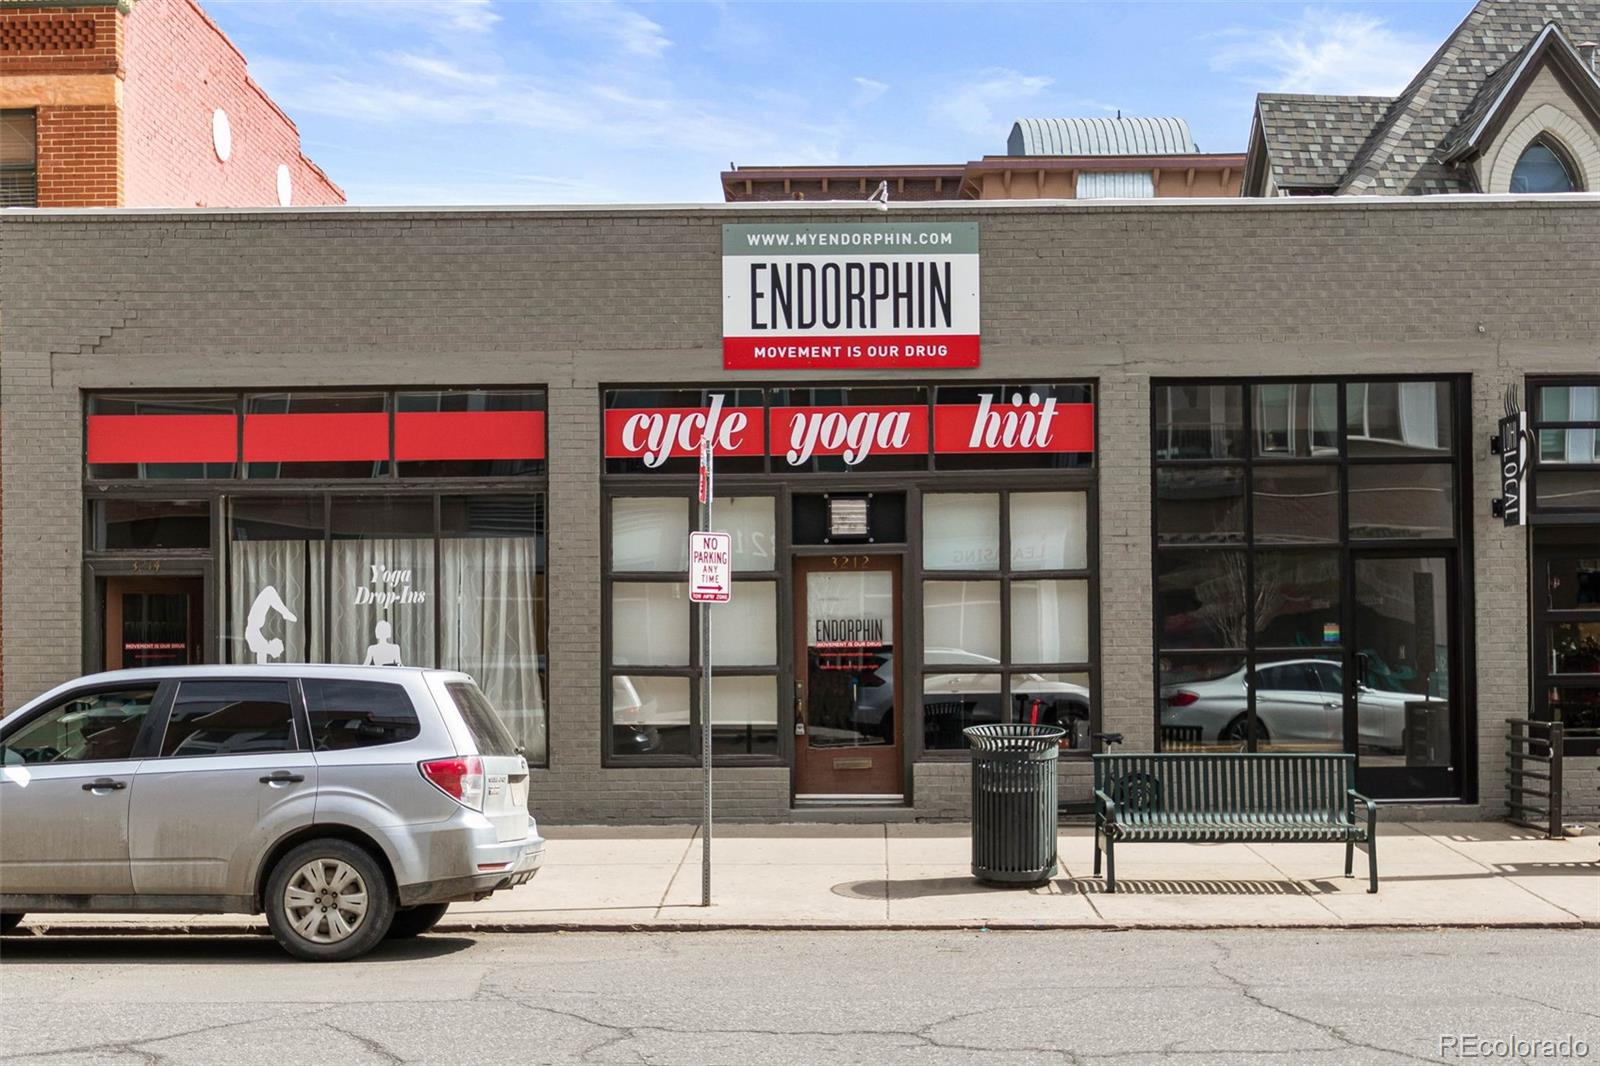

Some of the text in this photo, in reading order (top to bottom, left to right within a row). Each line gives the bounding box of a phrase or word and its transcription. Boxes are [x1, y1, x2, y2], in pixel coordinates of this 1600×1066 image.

[747, 232, 952, 246] WWW.MYENDORPHIN.COM
[750, 262, 952, 330] ENDORPHIN
[754, 345, 948, 358] MOVEMENT IS OUR DRUG
[622, 392, 1059, 468] cycle yoga hiit
[1504, 450, 1518, 519] LOCAL
[703, 537, 719, 550] NO
[694, 551, 727, 565] PARKING
[831, 556, 869, 569] 3212
[371, 565, 412, 587] Yoga
[702, 565, 718, 574] ANY
[701, 574, 720, 583] TIME
[353, 586, 426, 609] Drop-Ins
[816, 619, 883, 641] ENDORPHIN
